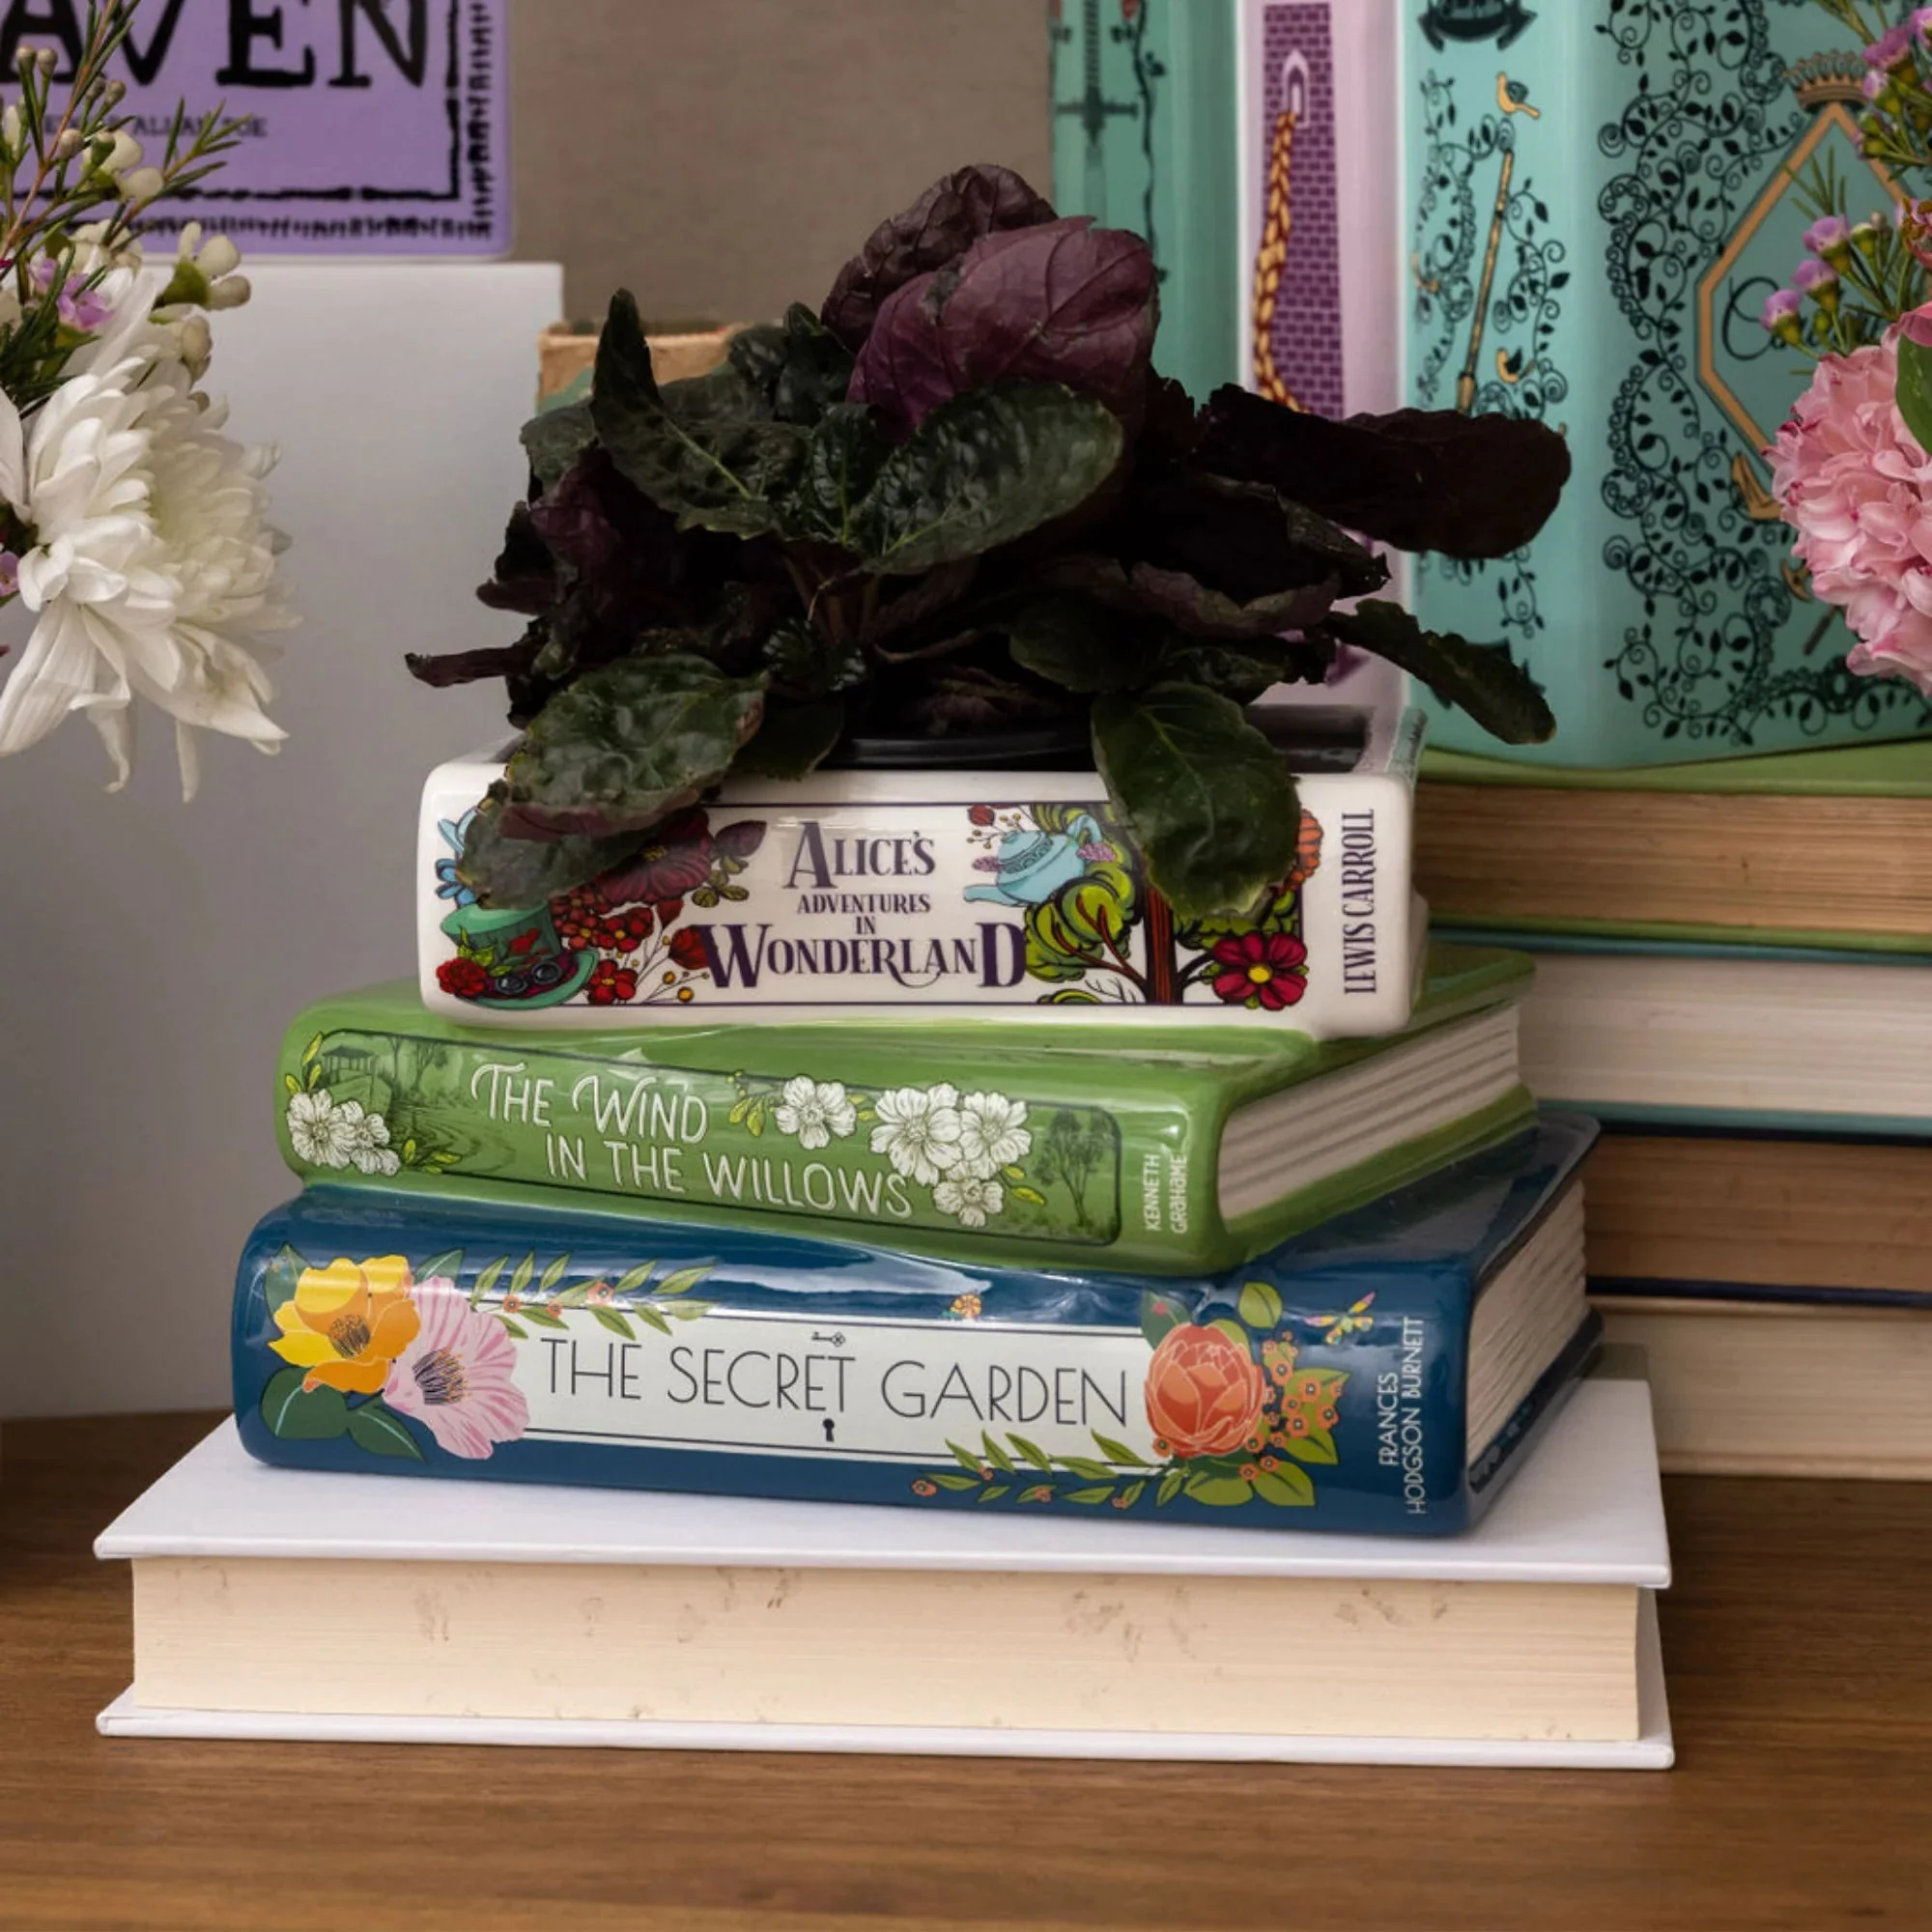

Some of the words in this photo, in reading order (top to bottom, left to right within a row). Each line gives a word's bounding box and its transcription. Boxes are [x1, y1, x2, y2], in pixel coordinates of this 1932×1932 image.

[133, 115, 209, 136] ALLA
[796, 893, 931, 915] ADVENTURES
[1341, 808, 1376, 919] CARROLL
[694, 922, 1027, 988] WONDERLAND
[854, 915, 877, 935] IN
[1343, 923, 1377, 994] LEWIS
[470, 1062, 554, 1128] THE
[572, 1074, 708, 1145] WIND
[545, 1132, 587, 1181] IN
[603, 1140, 686, 1193] THE
[702, 1151, 913, 1219] WILLOWS
[1143, 1153, 1162, 1232] KENNETH
[539, 1337, 642, 1400] THE
[667, 1346, 856, 1413] SECRET
[880, 1360, 1128, 1428] GARDEN
[1401, 1315, 1425, 1400] BURNETT
[1378, 1371, 1400, 1466] FRANCES
[1401, 1406, 1428, 1516] HODGSON
